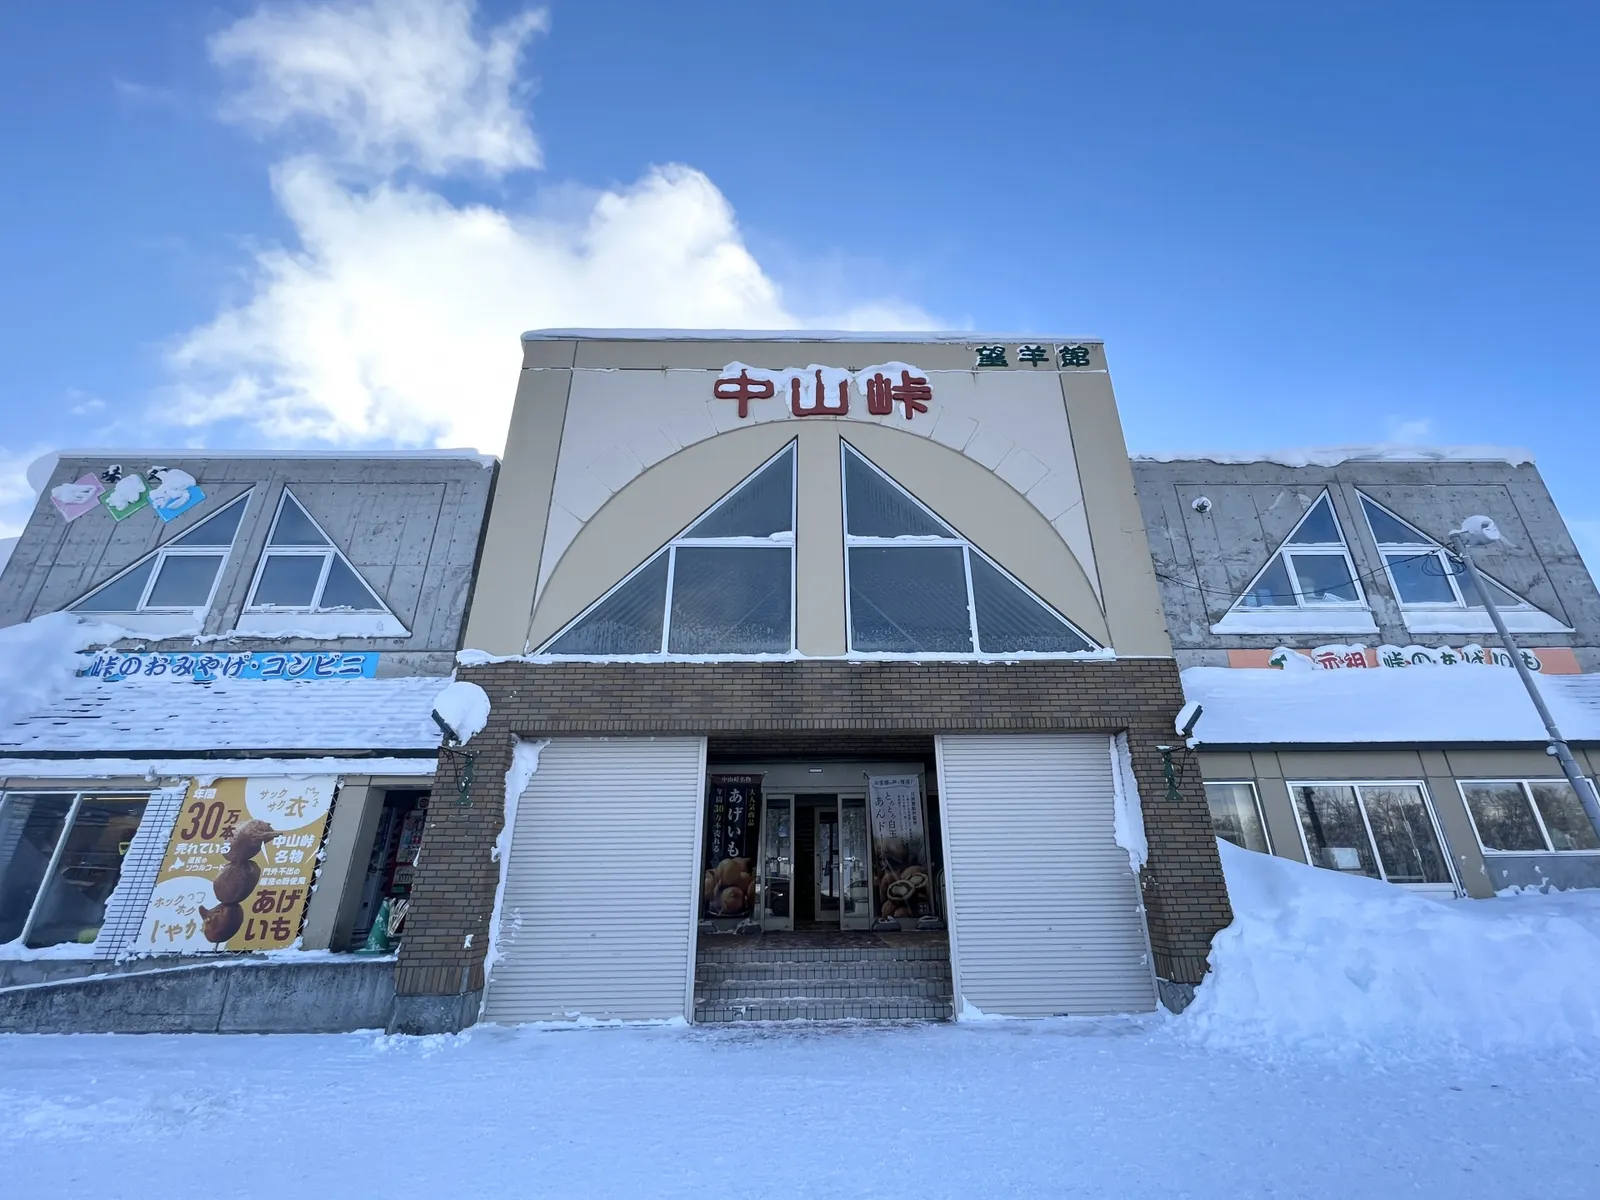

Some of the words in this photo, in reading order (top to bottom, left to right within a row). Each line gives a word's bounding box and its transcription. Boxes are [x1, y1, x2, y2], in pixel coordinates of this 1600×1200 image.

[975, 345, 1090, 367] 望羊館
[714, 368, 932, 419] 中山峠
[90, 653, 364, 678] 峠のおみやげ・コンビニ
[192, 788, 217, 799] 年間
[284, 796, 309, 818] 衣
[727, 788, 744, 857] あげいも
[174, 843, 231, 855] 売れている
[272, 833, 315, 848] 中山峠
[274, 850, 305, 864] 名物
[262, 867, 300, 876] 門外不出の
[252, 889, 303, 914] あげ
[244, 917, 291, 941] いも
